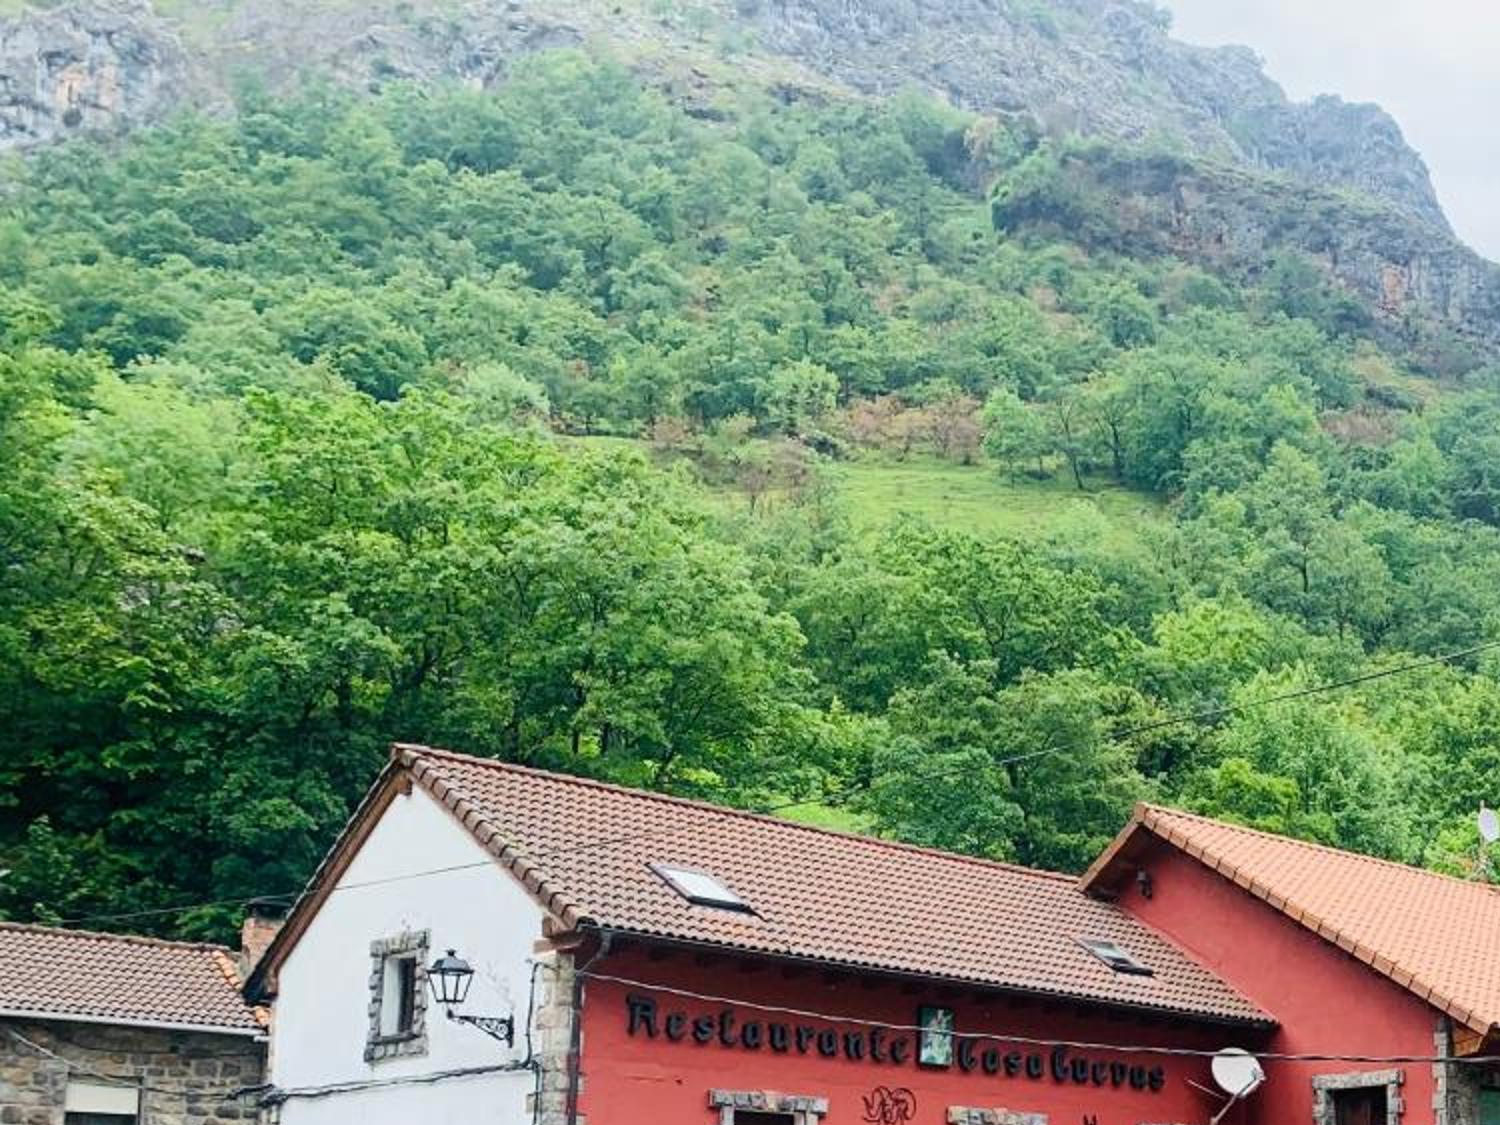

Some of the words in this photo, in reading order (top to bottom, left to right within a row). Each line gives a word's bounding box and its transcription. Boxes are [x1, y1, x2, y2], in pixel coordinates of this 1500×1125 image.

[626, 994, 912, 1064] Restaurante
[957, 1038, 1045, 1080] Casa
[1051, 1044, 1167, 1091] Cuevas
